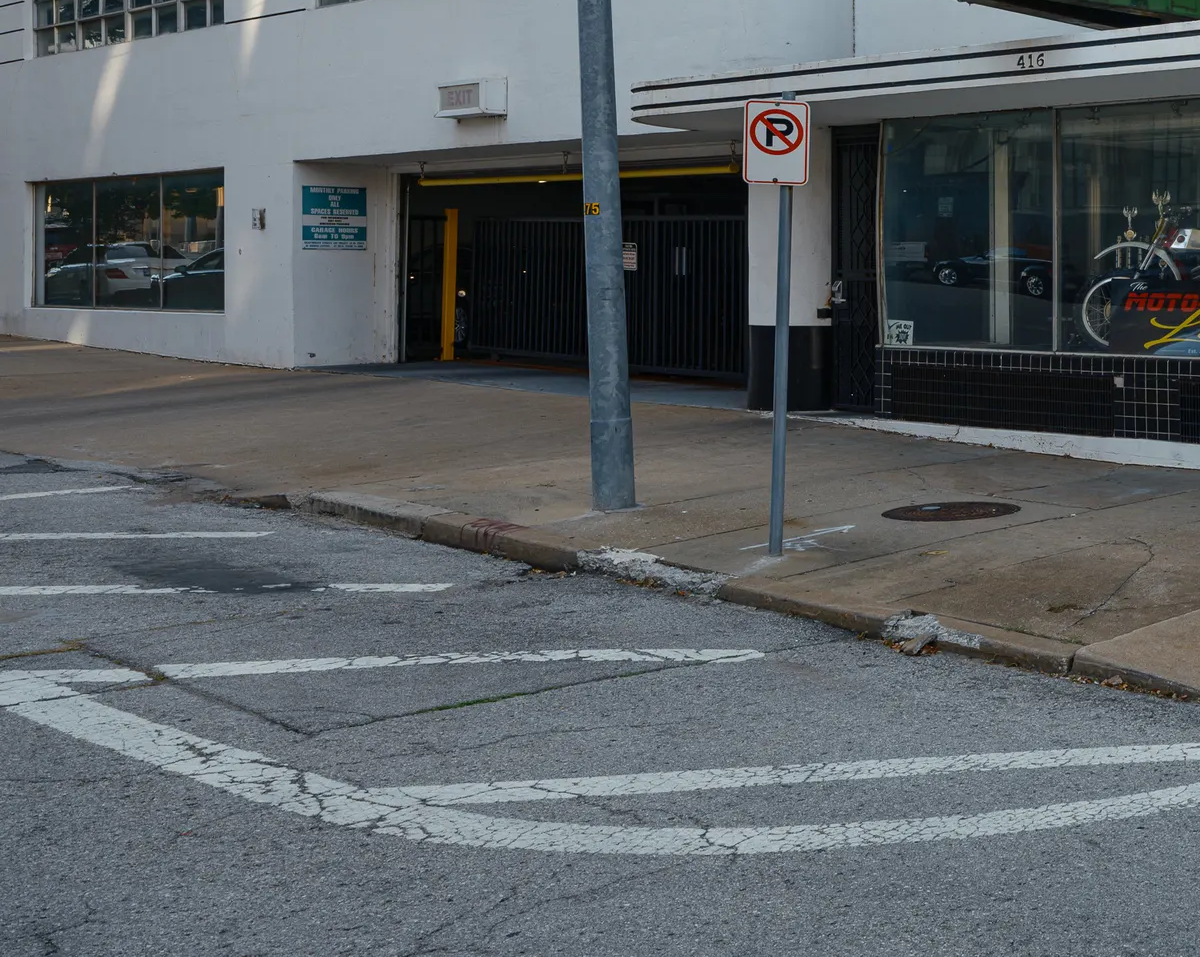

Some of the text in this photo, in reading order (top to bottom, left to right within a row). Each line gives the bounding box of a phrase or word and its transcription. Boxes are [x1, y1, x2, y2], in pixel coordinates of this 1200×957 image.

[1017, 53, 1045, 69] 416
[447, 89, 473, 106] EXIT
[584, 203, 600, 215] 75
[1130, 281, 1148, 291] The
